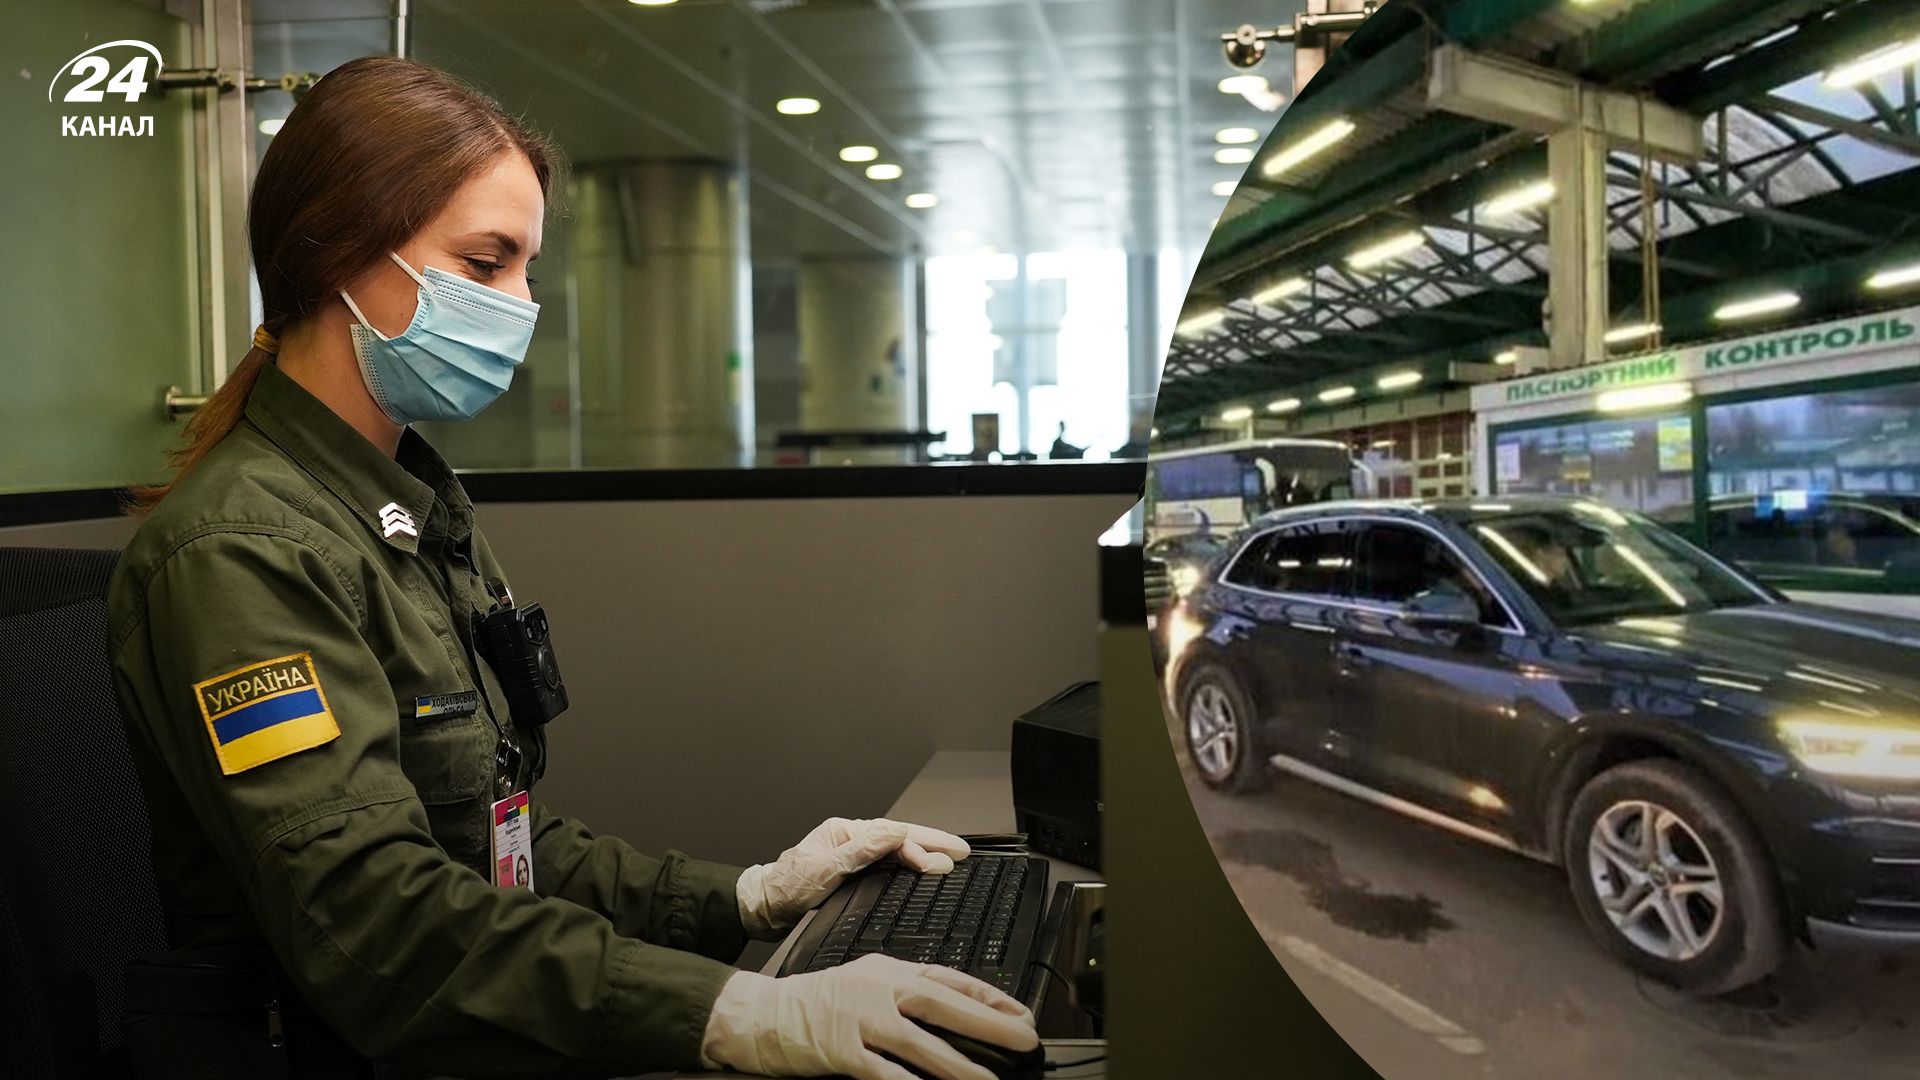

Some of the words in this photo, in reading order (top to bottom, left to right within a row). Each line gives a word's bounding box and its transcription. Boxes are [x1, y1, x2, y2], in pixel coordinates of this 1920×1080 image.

[1506, 353, 1677, 401] ПАСПОРТНИЙ
[1704, 318, 1915, 369] КОНТРОЛЬ
[208, 666, 308, 712] УКРАЇНА
